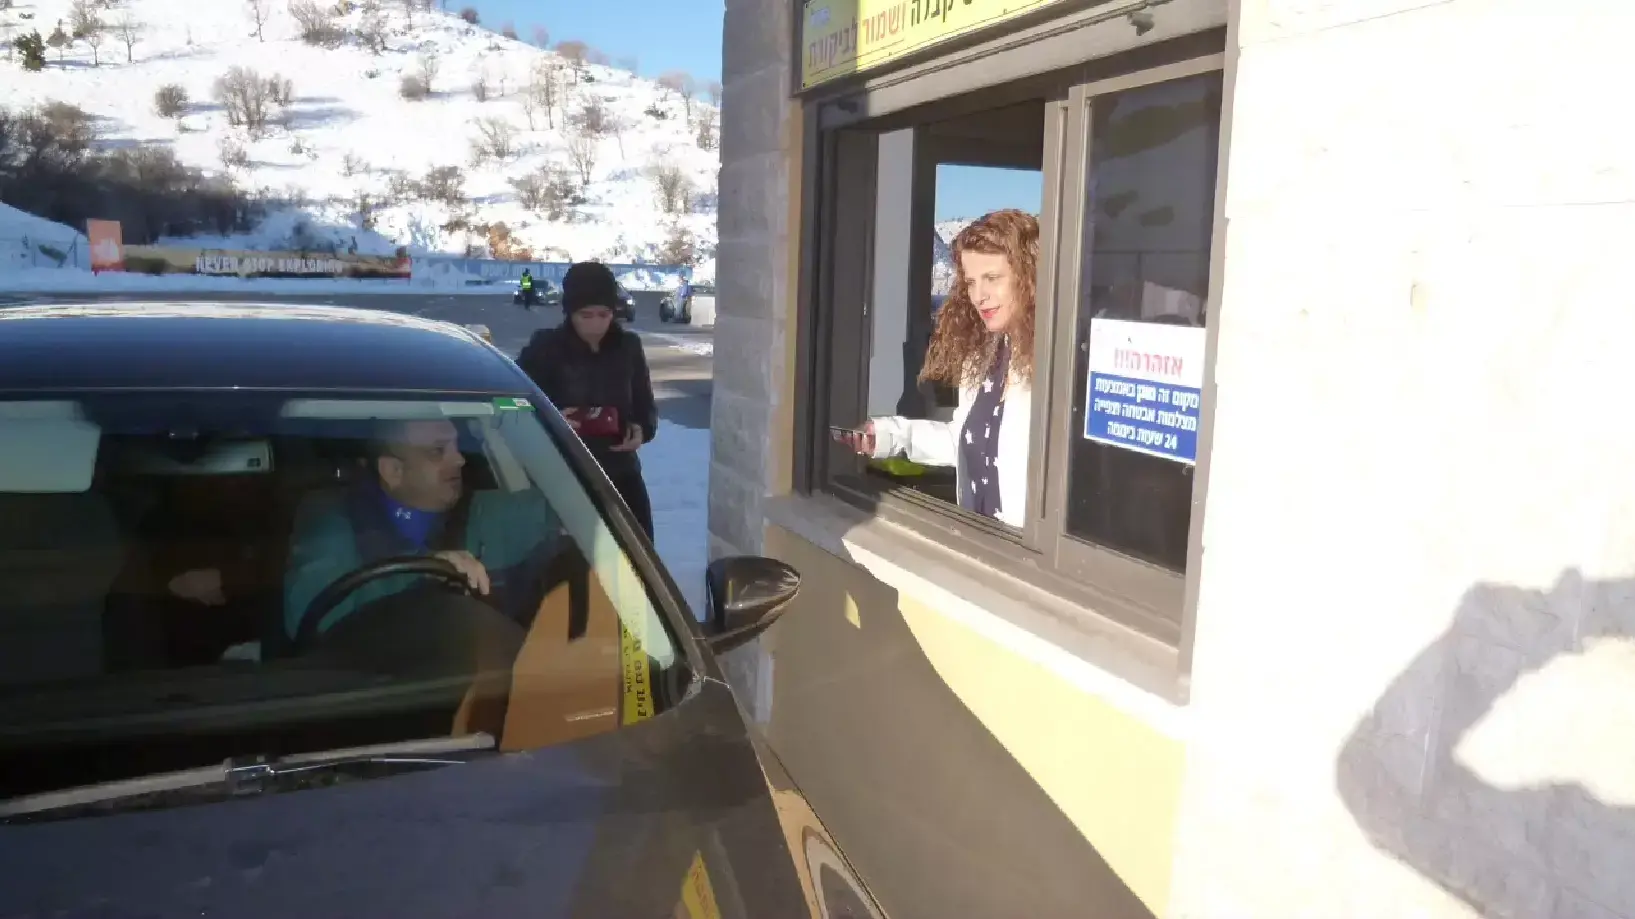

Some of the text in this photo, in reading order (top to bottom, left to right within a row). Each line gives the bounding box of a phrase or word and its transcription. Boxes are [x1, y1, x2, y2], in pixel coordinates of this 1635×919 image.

[862, 2, 907, 45] ושמור
[808, 16, 859, 69] לביקורת
[195, 255, 239, 273] NEVER
[243, 256, 275, 272] STOP
[1094, 377, 1136, 397] באמצעות
[1157, 388, 1171, 403] זה
[1121, 402, 1156, 422] אבטחה
[1172, 390, 1200, 412] מקום
[1156, 410, 1198, 432] מצלמות
[1107, 420, 1178, 450] 24 שעות ביממה
